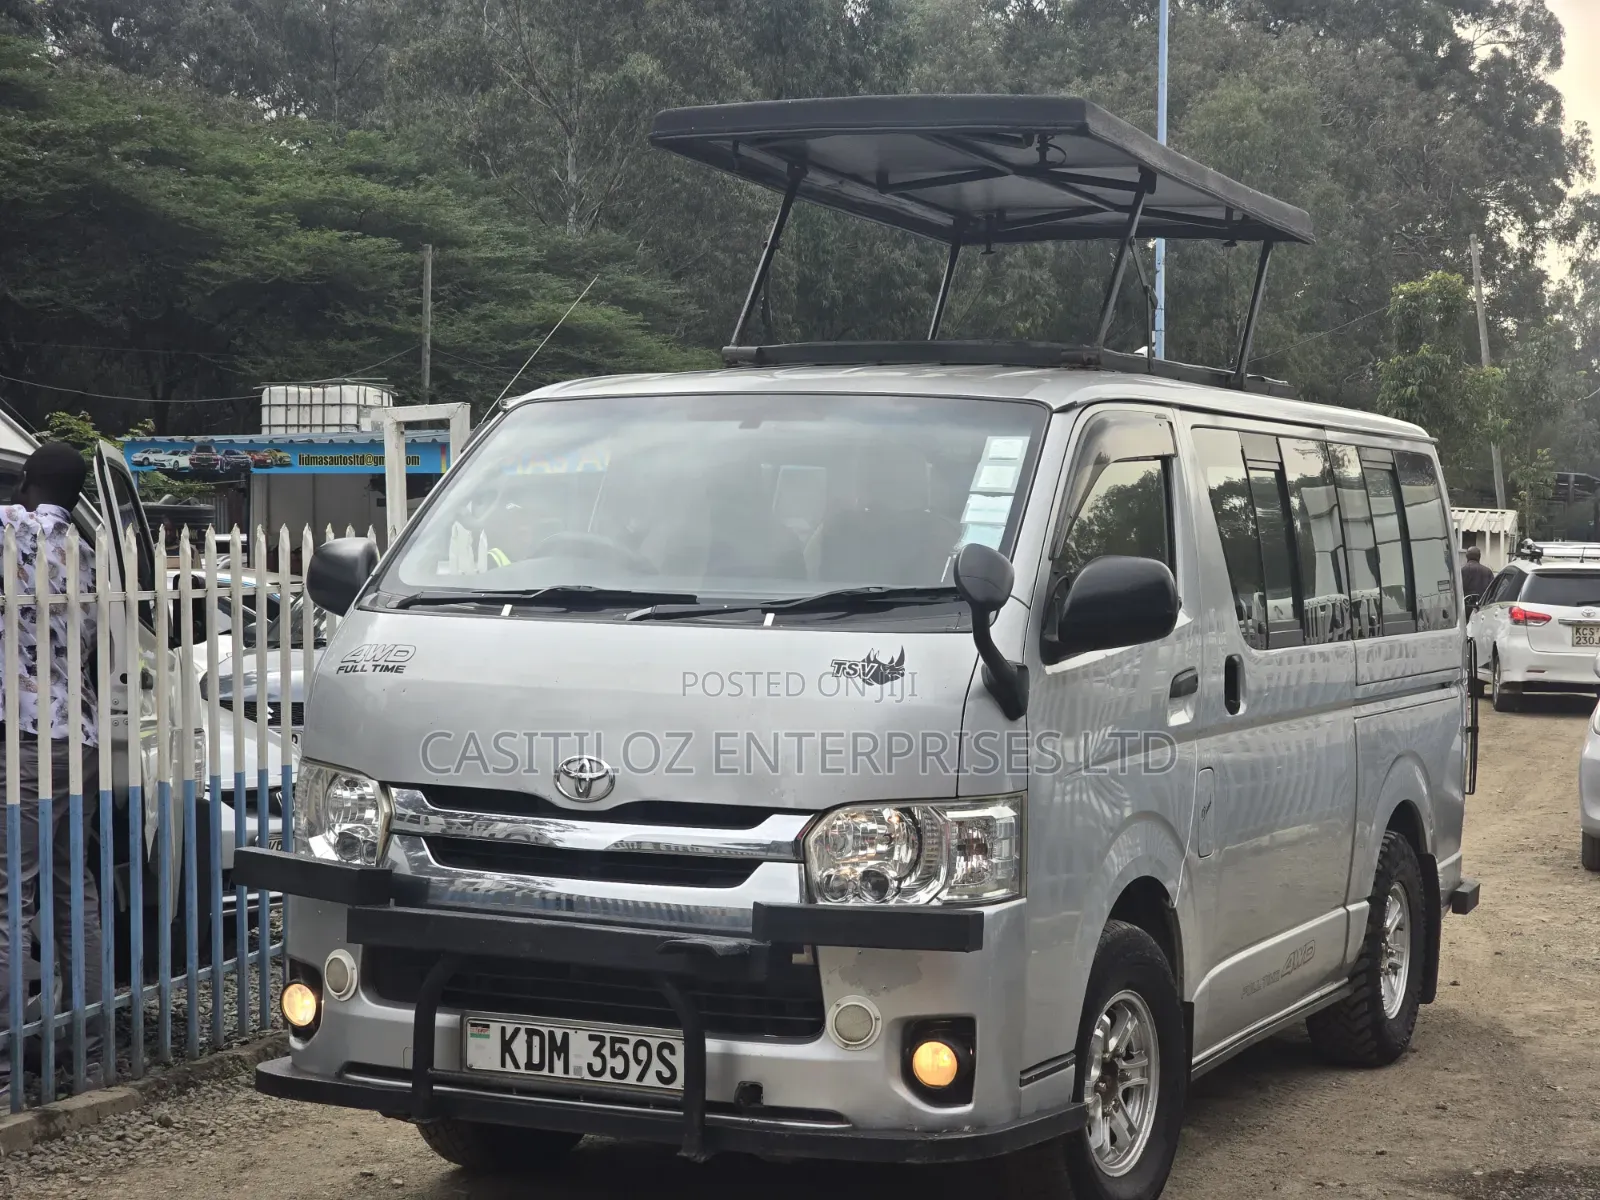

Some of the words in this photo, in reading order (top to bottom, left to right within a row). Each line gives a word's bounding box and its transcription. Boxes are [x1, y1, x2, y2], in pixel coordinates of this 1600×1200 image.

[298, 453, 420, 467] lidmasautosltd@gmom
[1575, 627, 1595, 636] KCS
[336, 664, 368, 675] FULL
[371, 664, 407, 674] TIME
[830, 659, 879, 679] TSV
[500, 1025, 571, 1076] KDM
[586, 1033, 678, 1086] 359S
